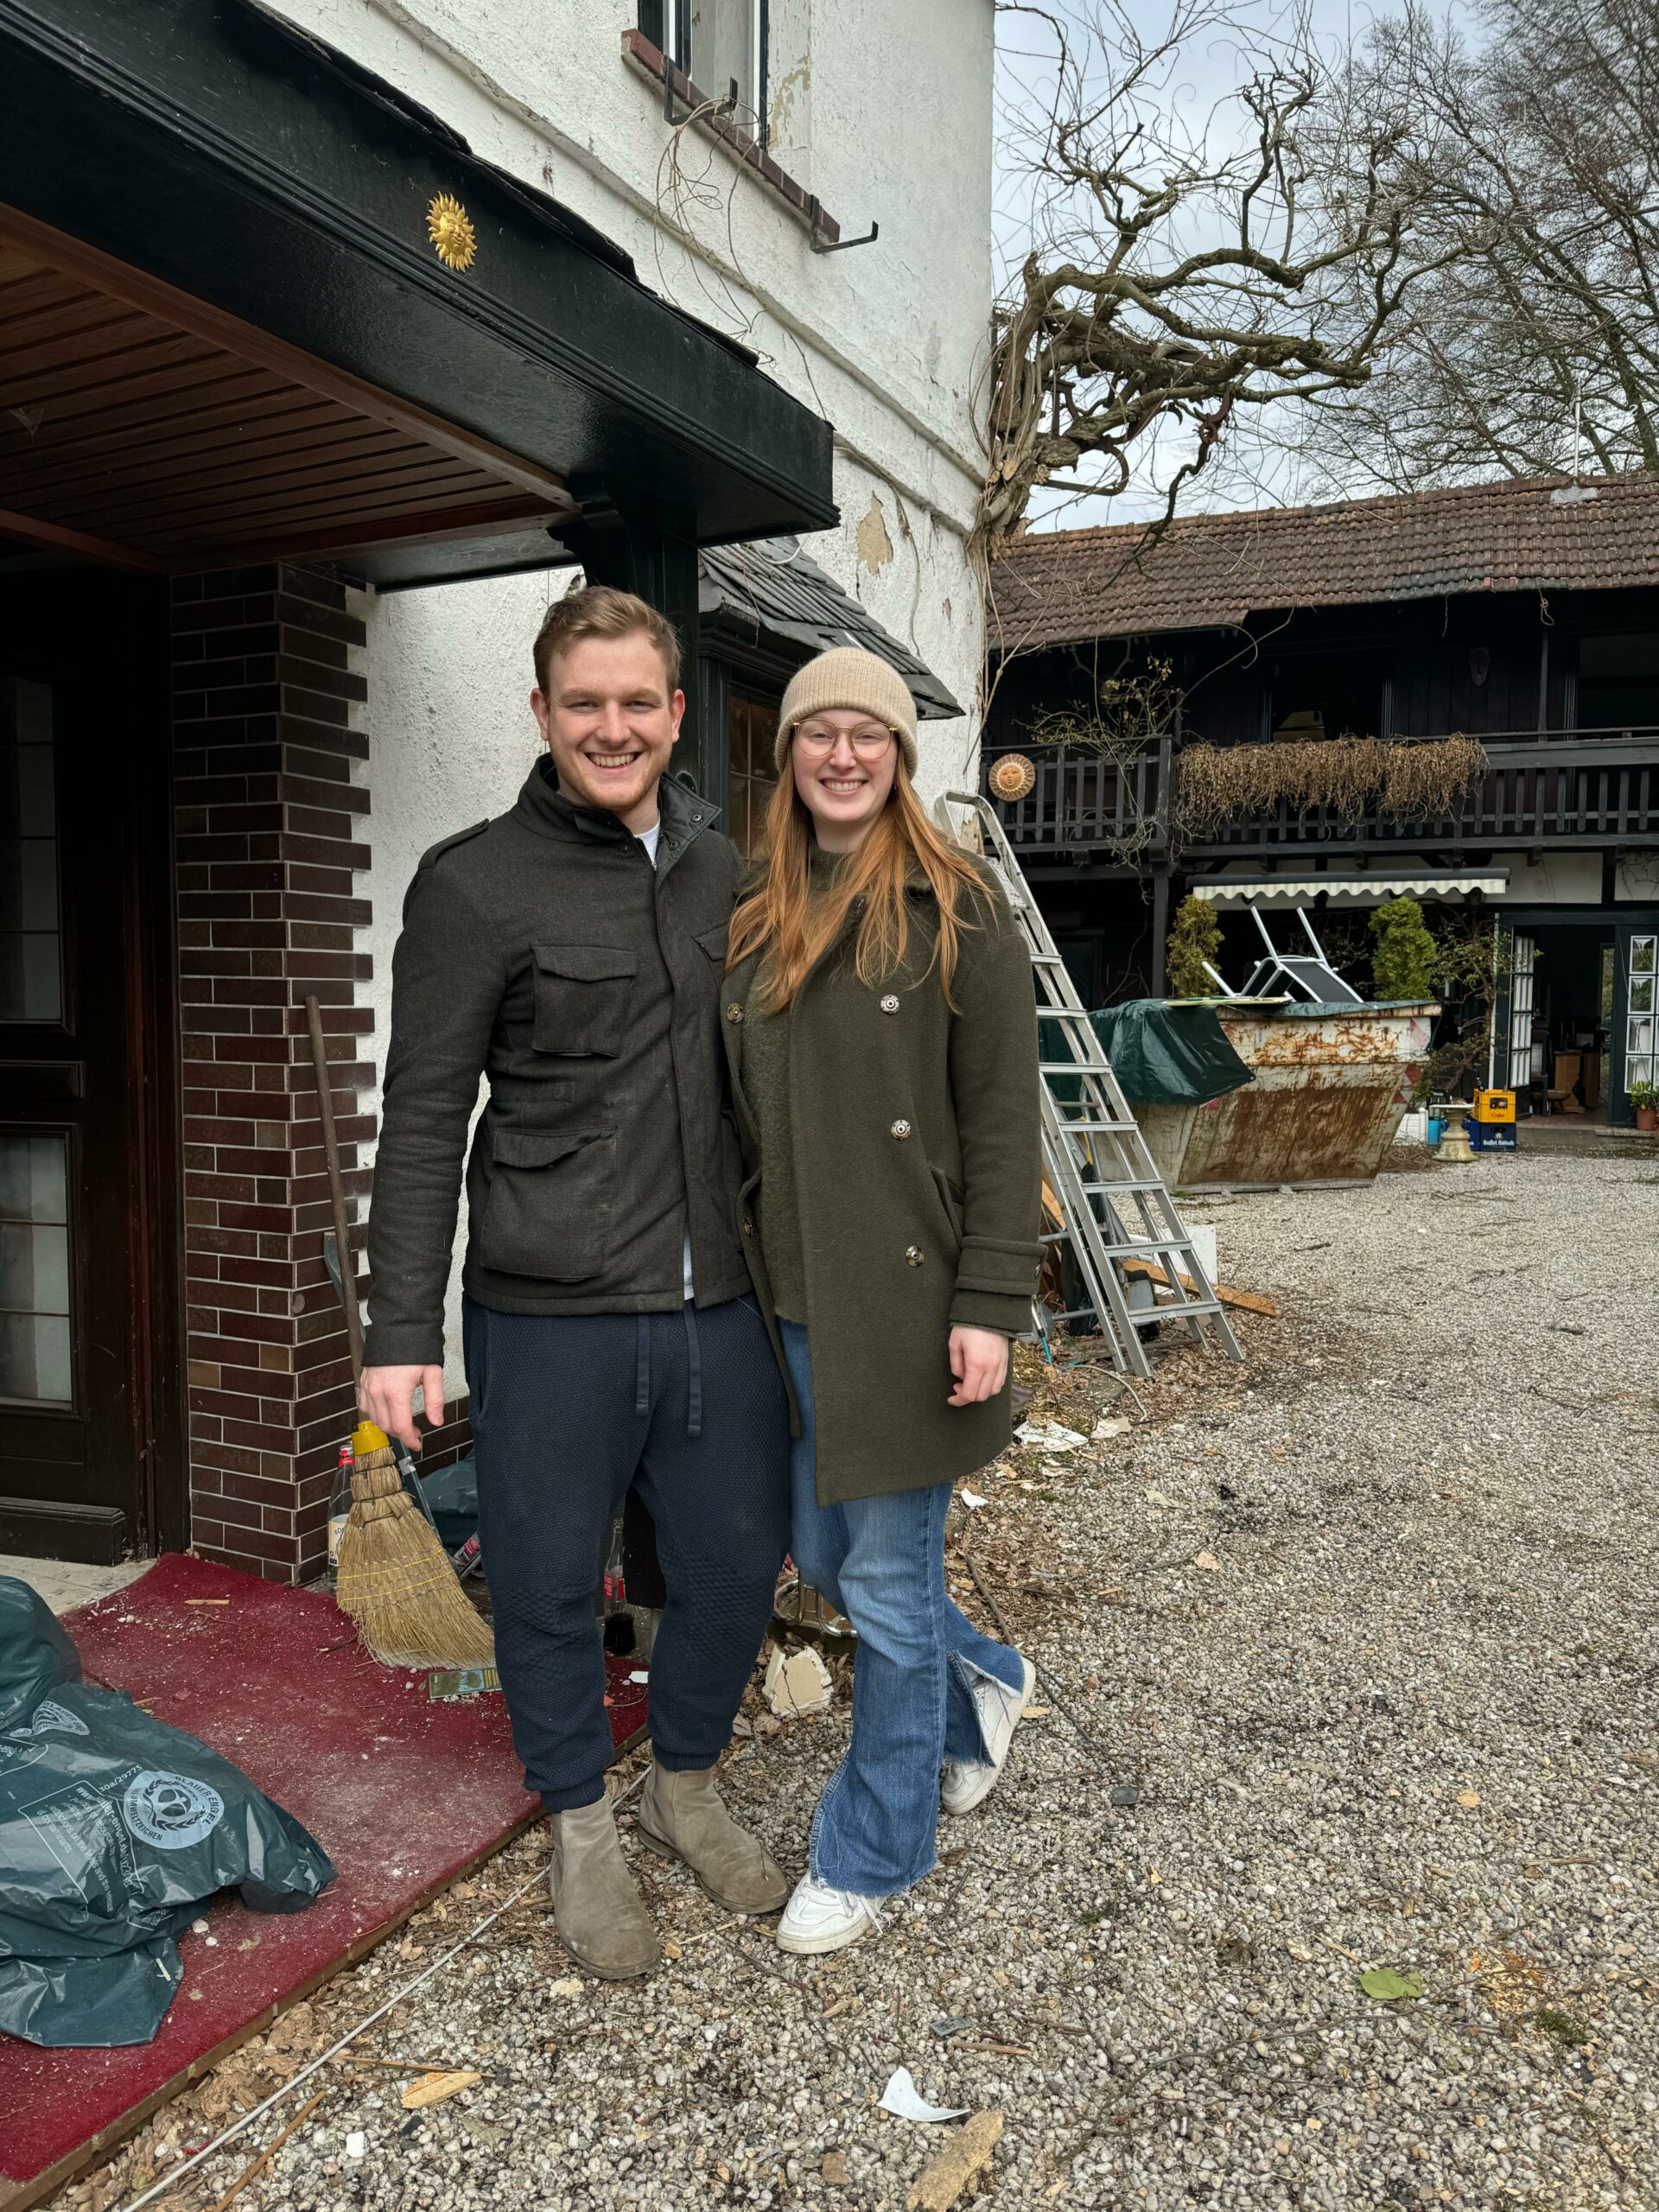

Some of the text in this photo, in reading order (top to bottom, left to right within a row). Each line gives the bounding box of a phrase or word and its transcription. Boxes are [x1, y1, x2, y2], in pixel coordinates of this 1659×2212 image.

[99, 1764, 143, 1793] 30a/29775
[130, 1795, 163, 1841] UMWELTZEICHEN
[175, 1776, 219, 1825] BLAUER ENGEL
[41, 1815, 73, 1853] contaminants
[95, 1866, 106, 1880] and
